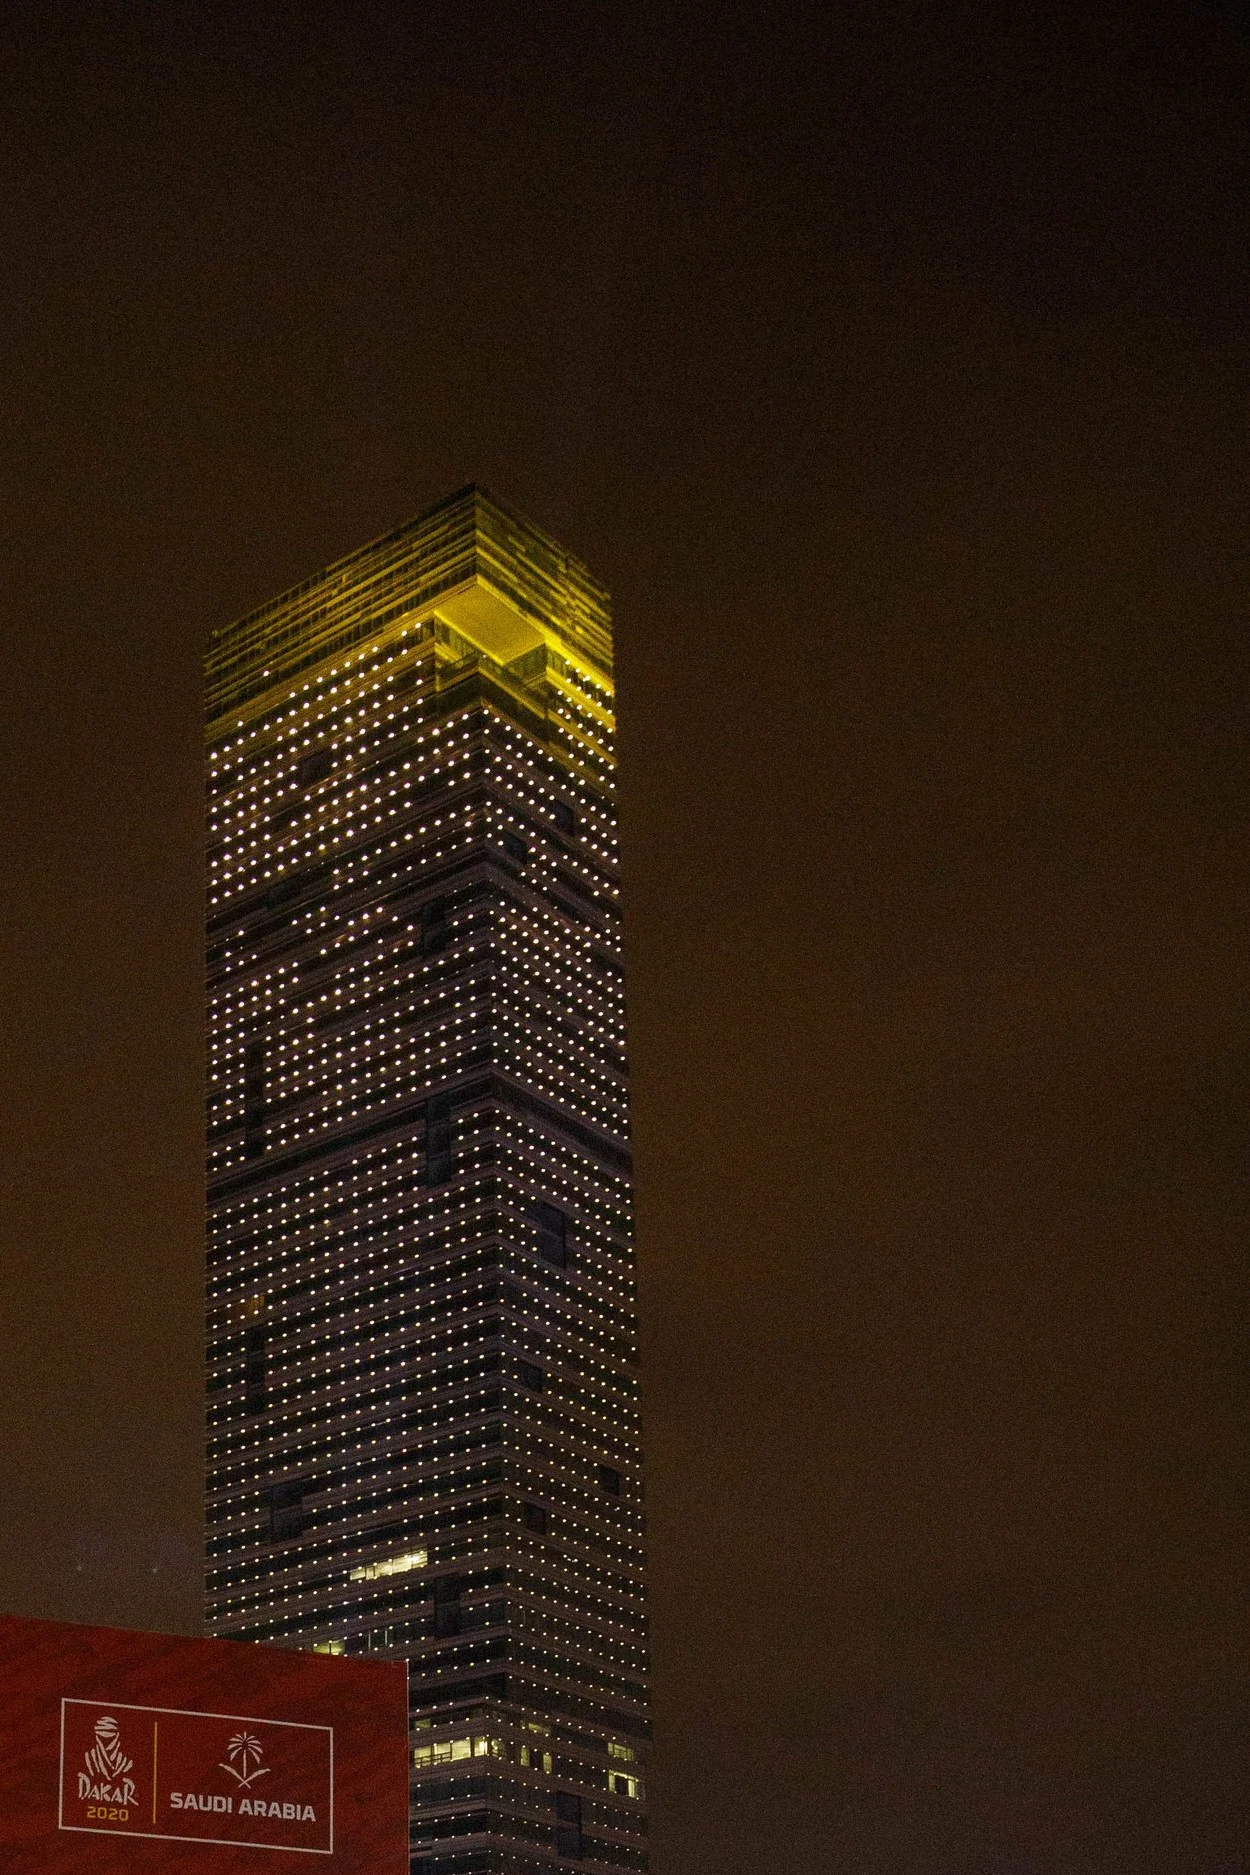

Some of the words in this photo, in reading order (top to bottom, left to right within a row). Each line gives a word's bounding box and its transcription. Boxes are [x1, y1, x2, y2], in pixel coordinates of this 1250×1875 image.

[78, 1772, 139, 1807] DAKAR
[86, 1805, 130, 1822] 2020
[170, 1791, 233, 1814] SAUDI
[239, 1798, 317, 1822] ARABIA
